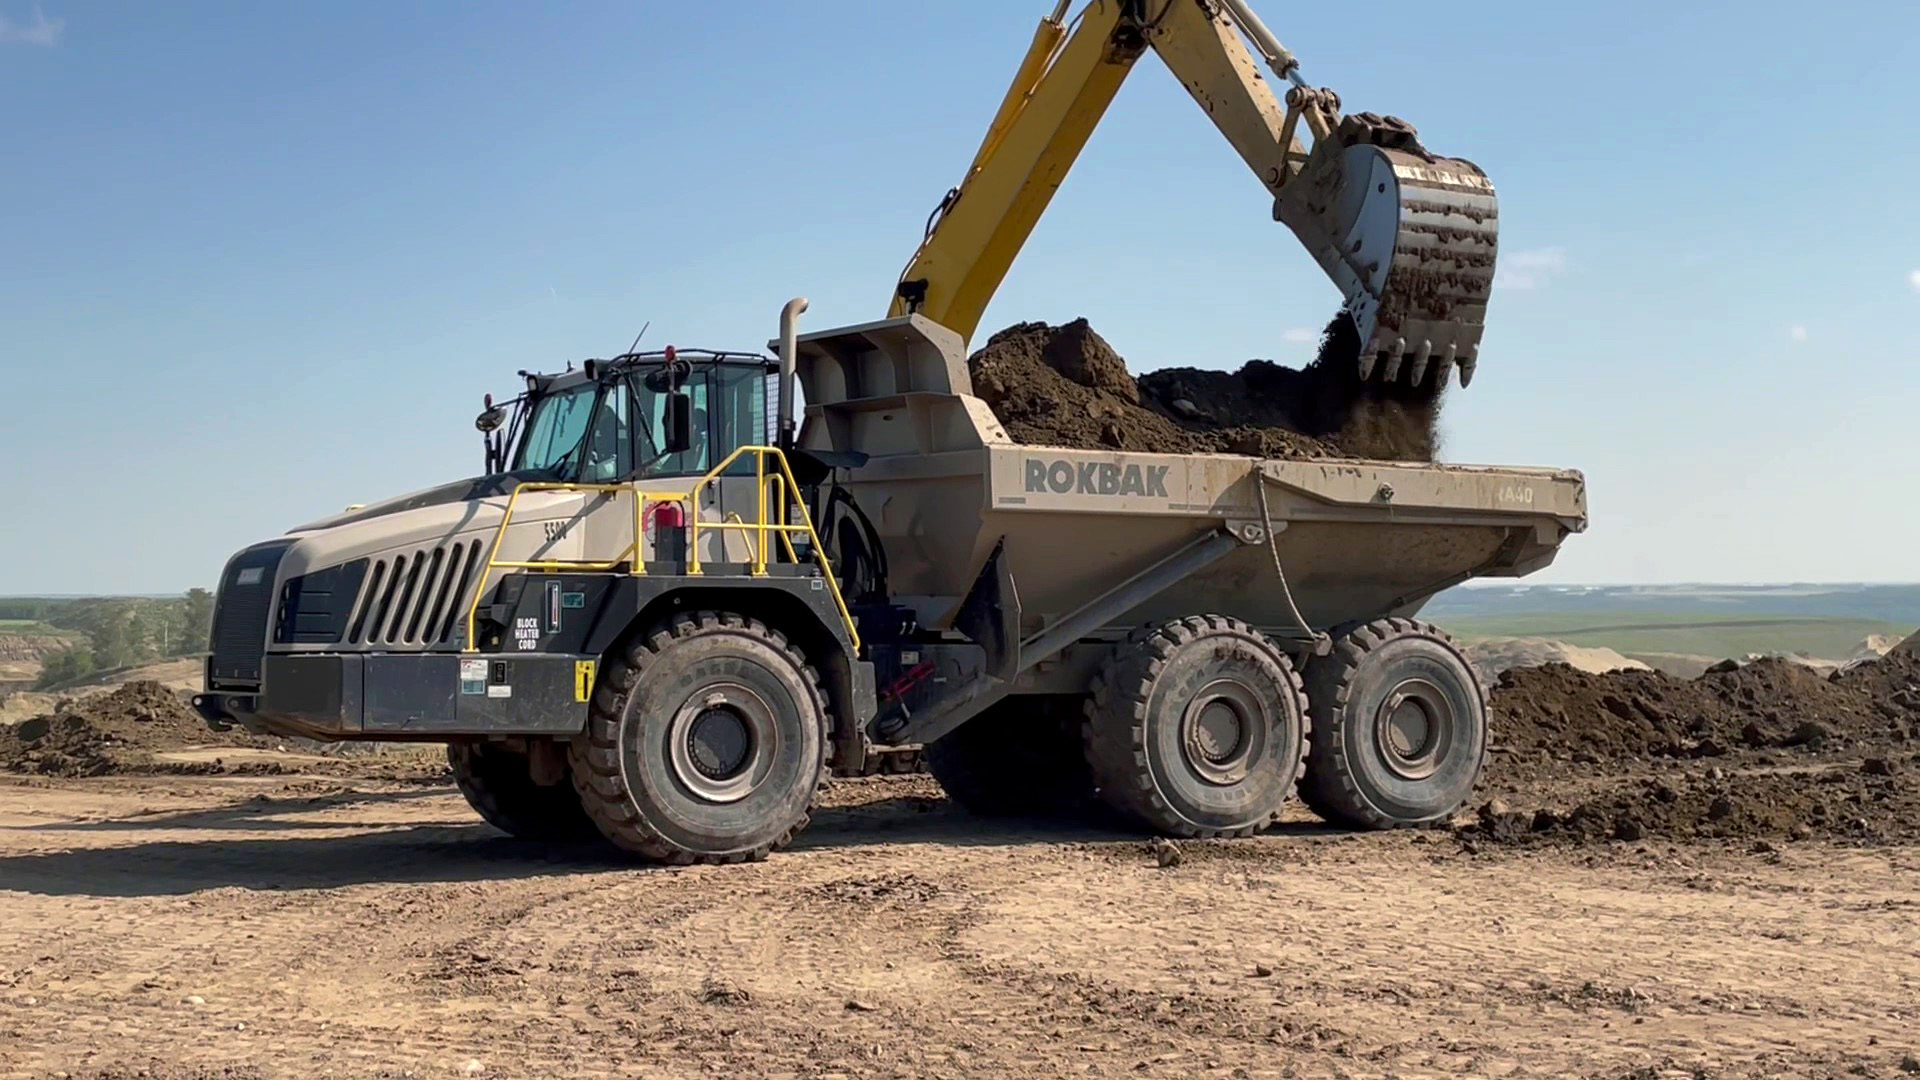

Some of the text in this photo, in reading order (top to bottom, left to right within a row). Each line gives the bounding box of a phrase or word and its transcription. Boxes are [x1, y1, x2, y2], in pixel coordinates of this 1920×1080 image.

[1025, 458, 1169, 498] ROKBAK
[517, 618, 537, 628] BLOCK
[515, 629, 539, 639] HEATER
[519, 639, 536, 650] CORD
